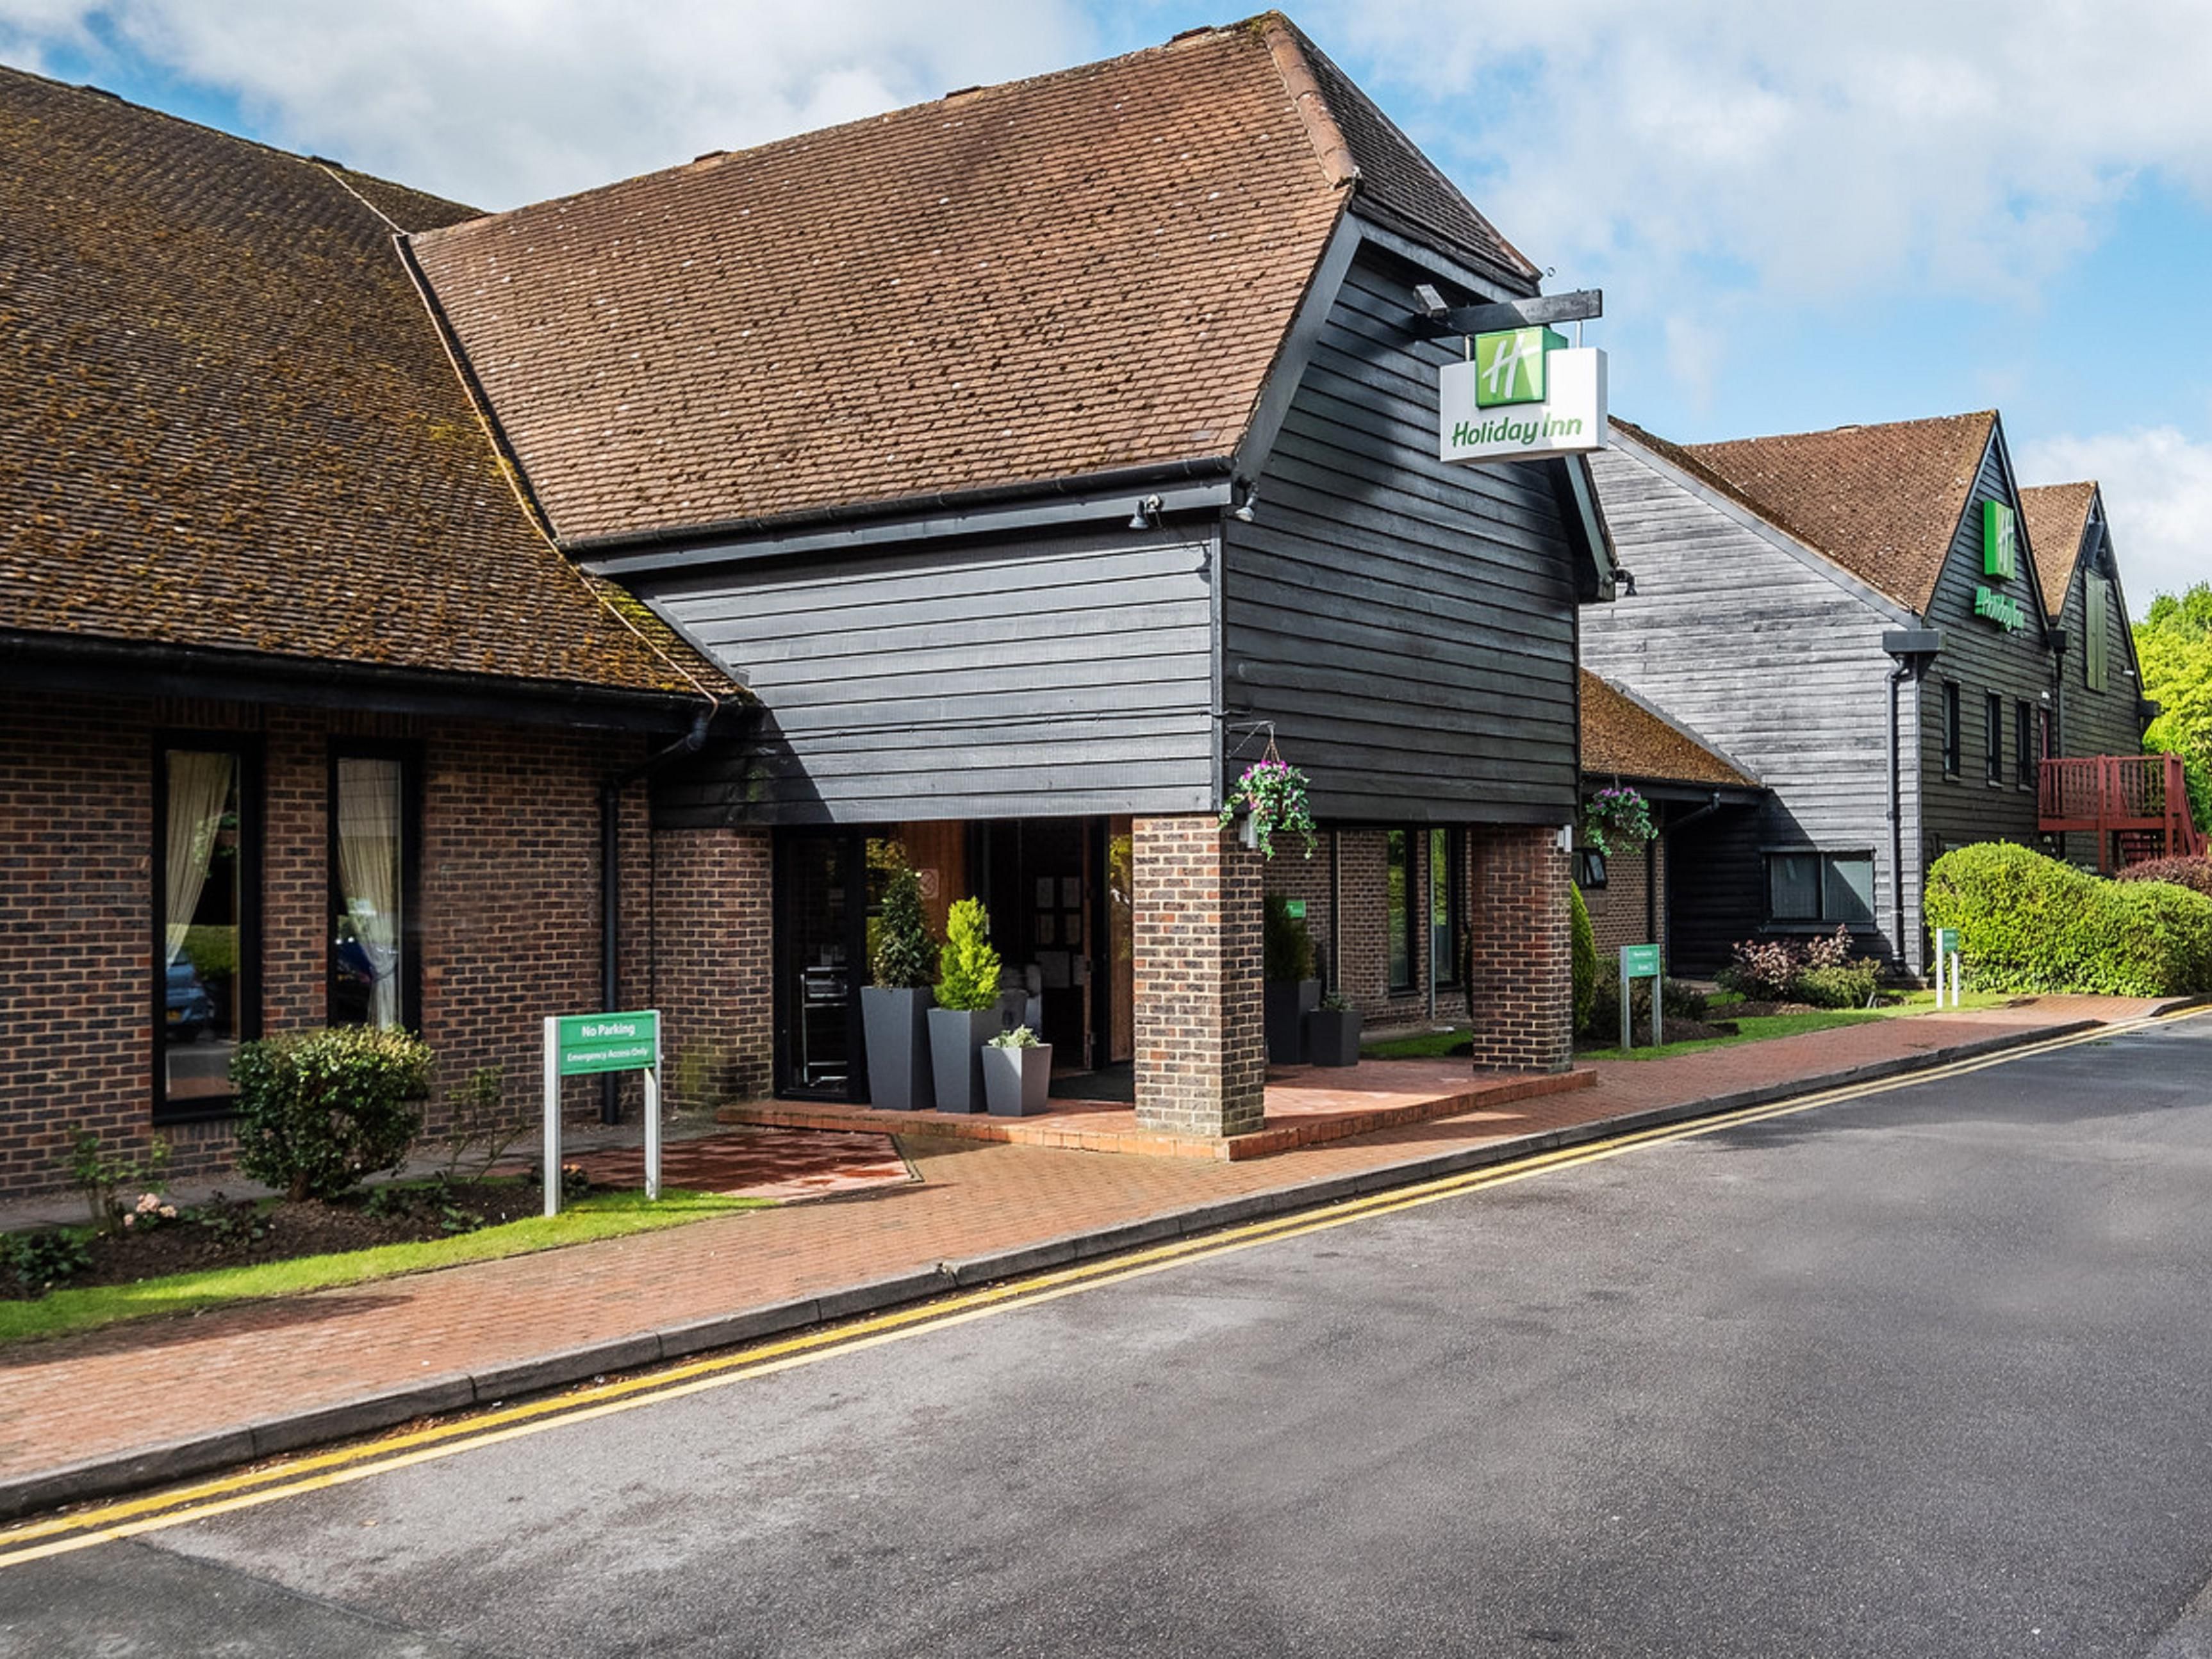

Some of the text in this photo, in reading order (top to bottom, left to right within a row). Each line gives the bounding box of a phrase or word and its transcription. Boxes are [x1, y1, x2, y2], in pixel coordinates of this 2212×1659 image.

[1452, 413, 1583, 447] Holiday Inn
[581, 1023, 636, 1037] No Parking
[567, 1052, 607, 1062] Emergency
[631, 1047, 648, 1057] Only
